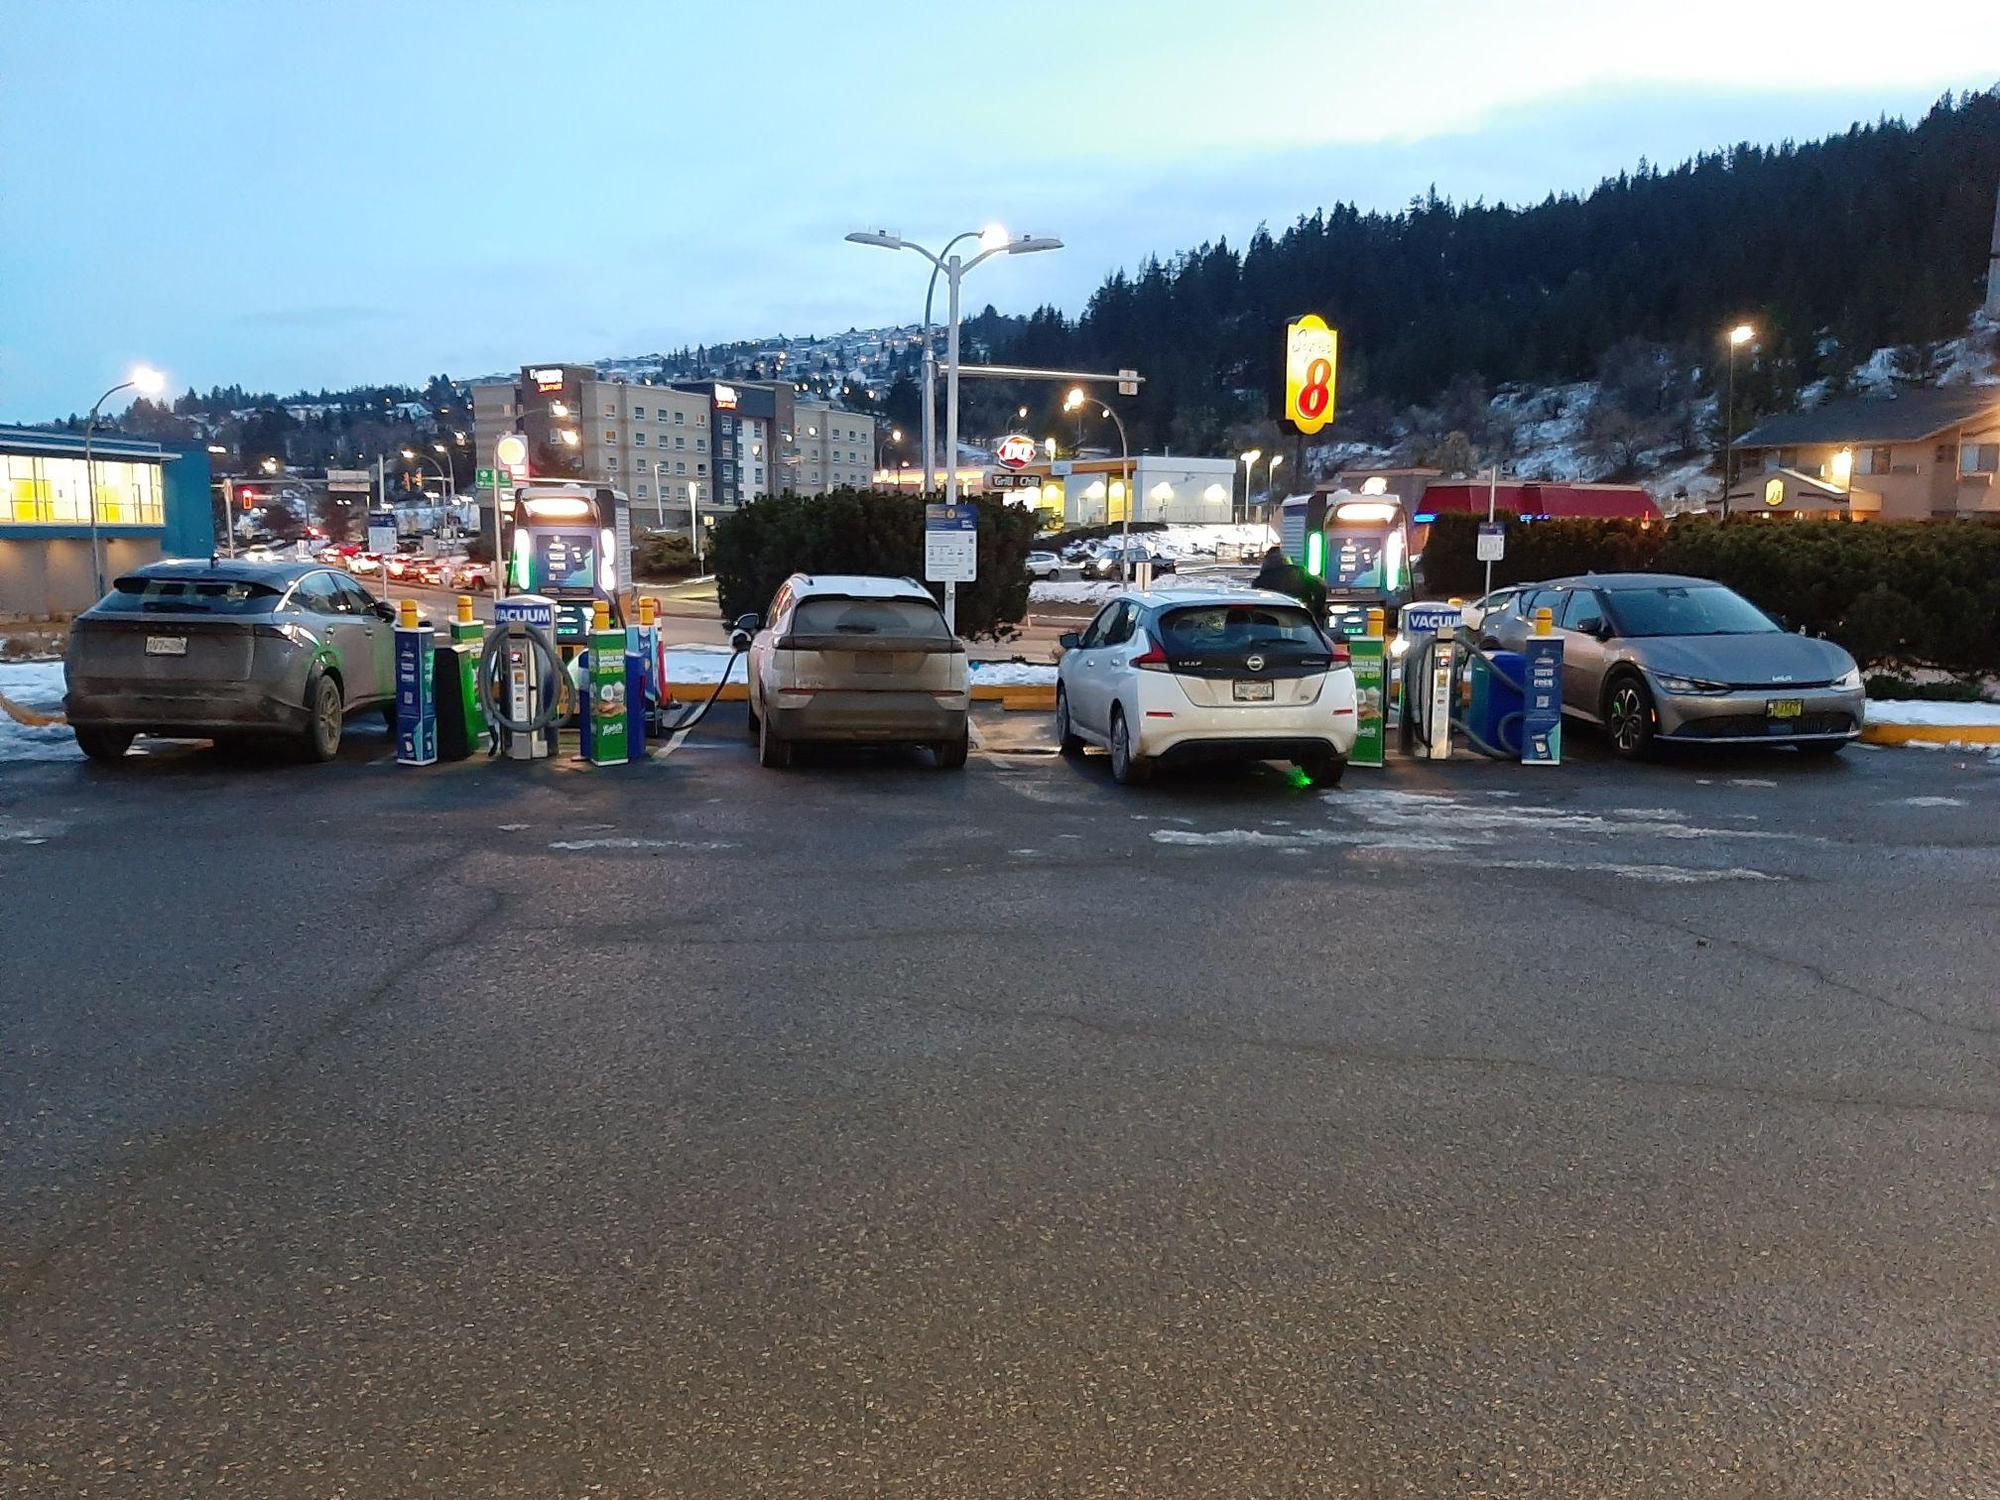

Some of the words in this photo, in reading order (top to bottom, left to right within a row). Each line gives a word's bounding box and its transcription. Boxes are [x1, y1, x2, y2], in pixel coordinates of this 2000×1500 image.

[1296, 358, 1332, 420] 8
[1004, 441, 1032, 462] DQ
[993, 475, 1014, 487] Grill
[1019, 476, 1040, 487] Chill
